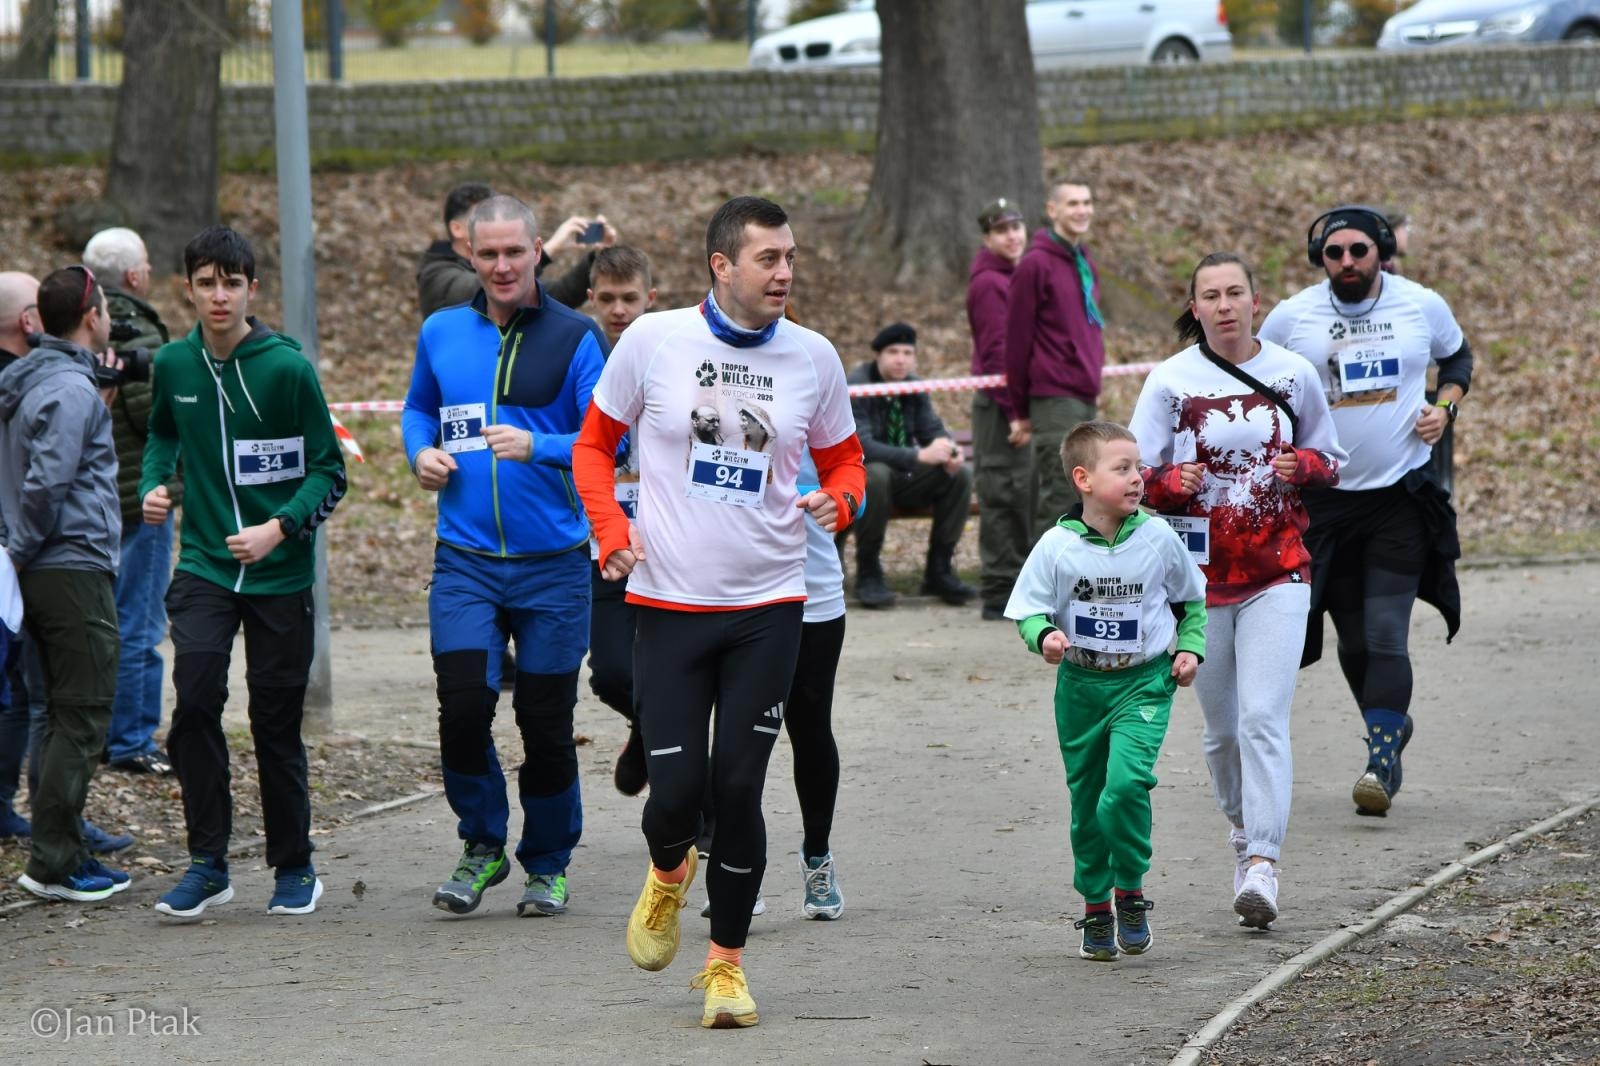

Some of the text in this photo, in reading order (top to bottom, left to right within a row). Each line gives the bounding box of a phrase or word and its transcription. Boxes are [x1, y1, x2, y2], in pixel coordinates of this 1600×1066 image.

[1350, 322, 1392, 335] WILCZYM
[721, 362, 749, 373] TROPEM
[1360, 360, 1383, 378] 71
[721, 371, 773, 389] WILCZYM
[757, 393, 774, 402] 2026
[451, 420, 468, 439] 33
[258, 454, 284, 472] 34
[723, 455, 749, 465] WILCZYM
[715, 465, 743, 488] 94
[1096, 577, 1122, 585] TROPEM
[1097, 583, 1143, 597] WILCZYM
[1094, 620, 1121, 639] 93
